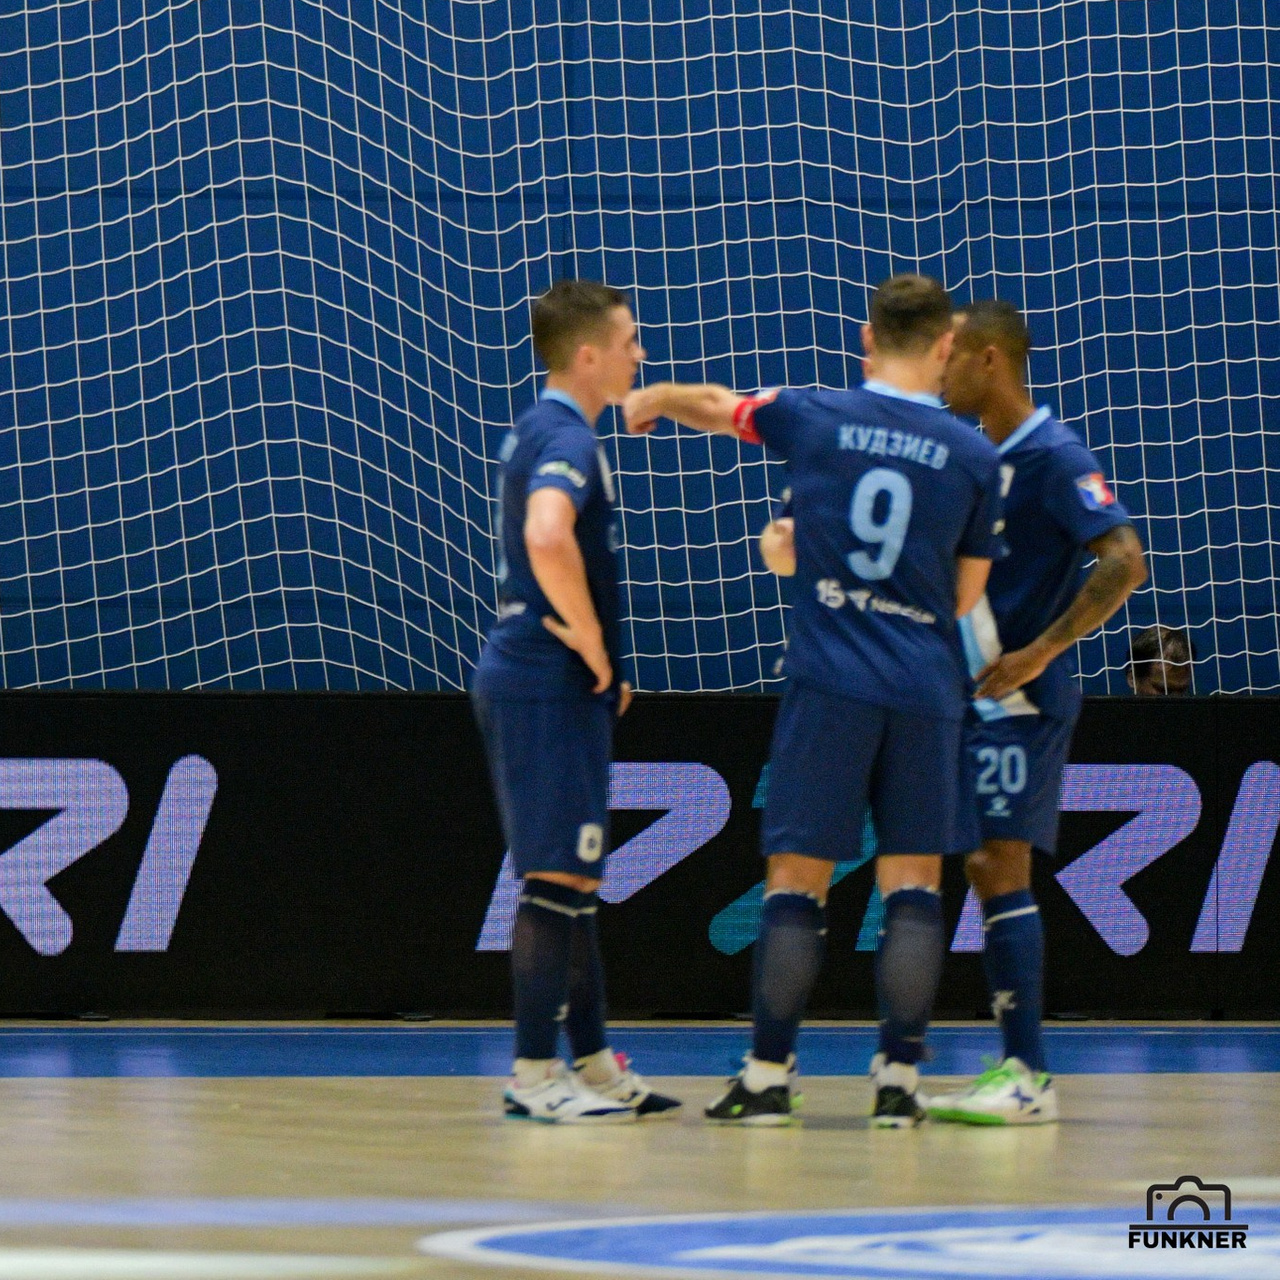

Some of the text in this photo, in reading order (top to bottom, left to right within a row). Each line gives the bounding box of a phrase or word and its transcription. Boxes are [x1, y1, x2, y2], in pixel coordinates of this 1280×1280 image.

[837, 424, 950, 471] КУДЗИЕВ
[847, 467, 913, 581] 9
[976, 745, 1027, 795] 20
